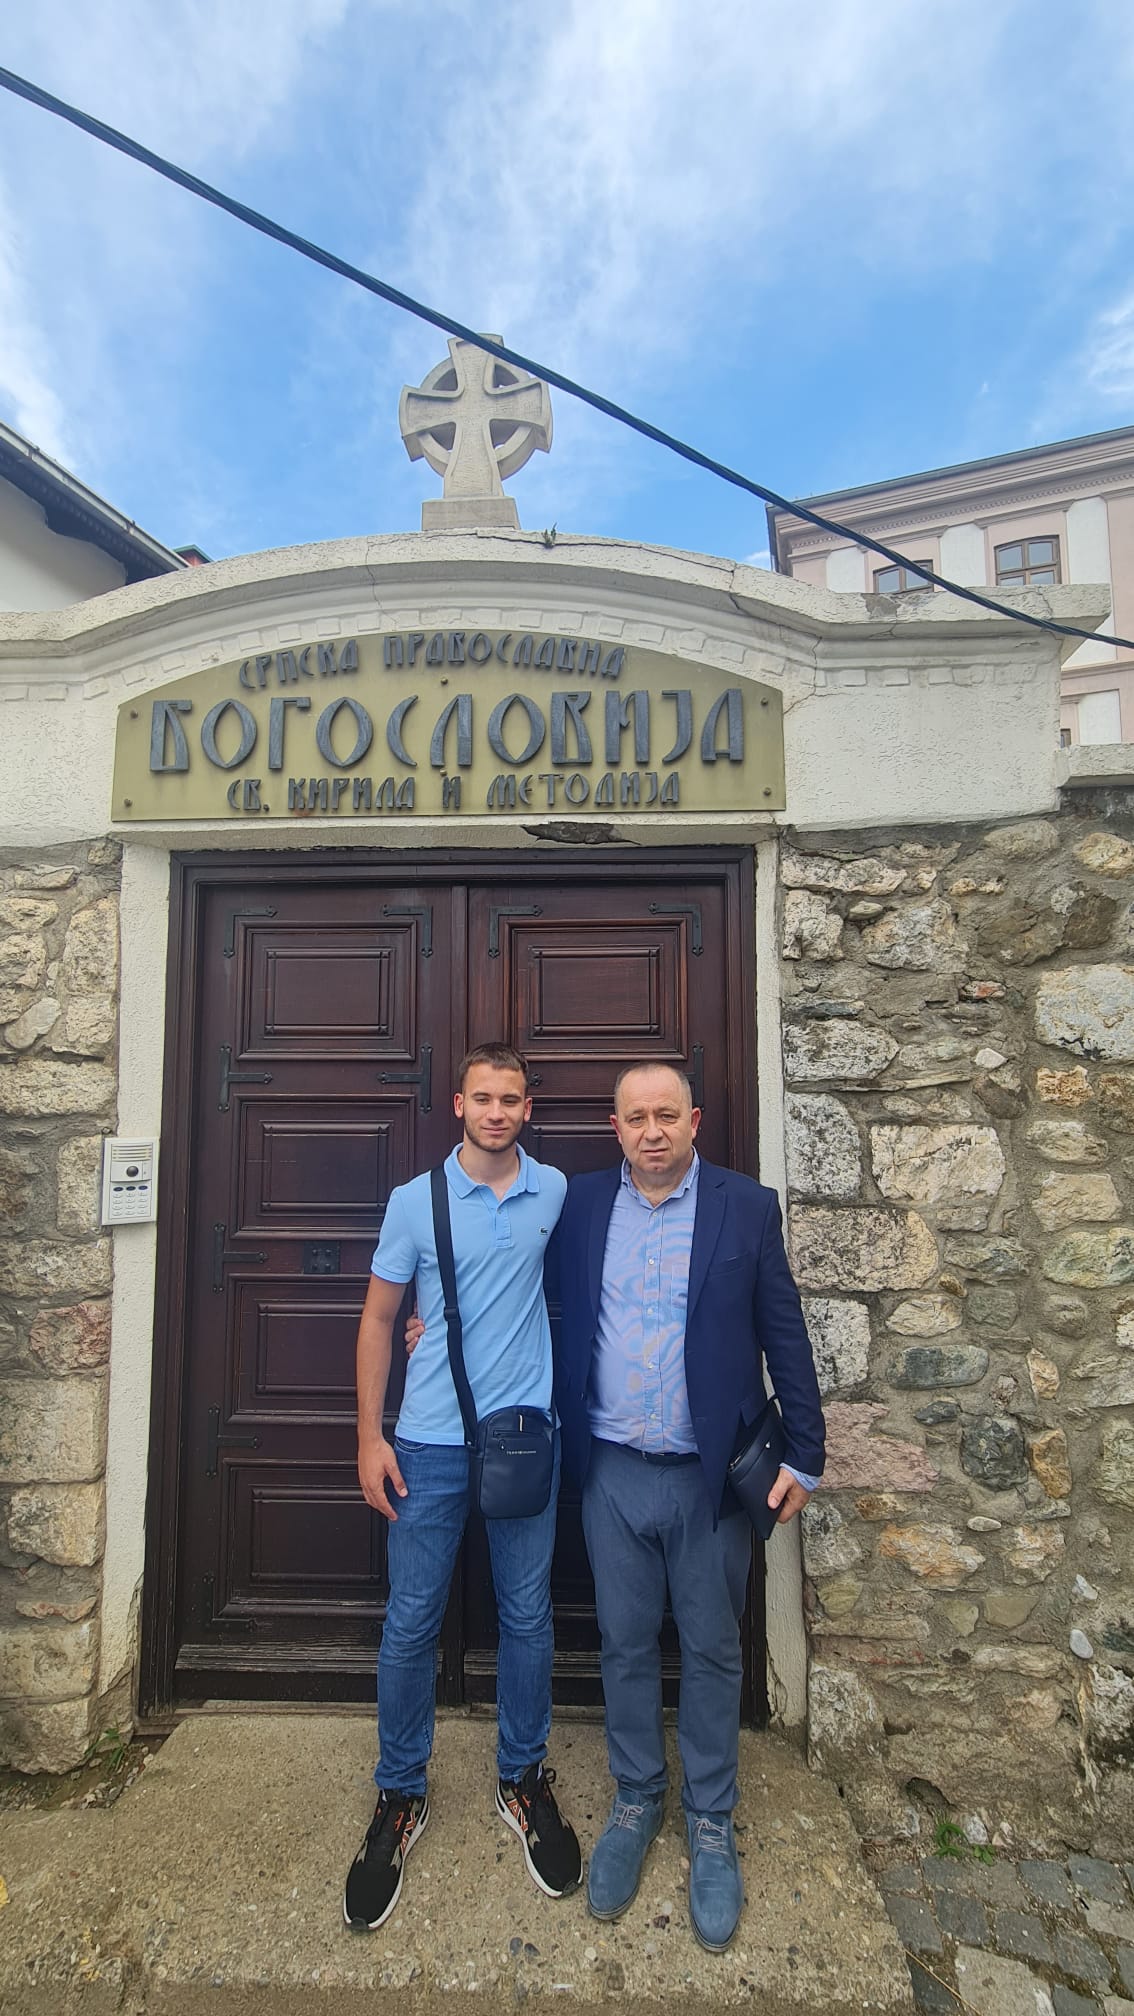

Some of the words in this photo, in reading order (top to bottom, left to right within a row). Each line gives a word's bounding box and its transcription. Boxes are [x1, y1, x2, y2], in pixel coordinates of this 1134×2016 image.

[239, 639, 359, 689] СРПСКА
[383, 631, 625, 678] ПРАВОСЛАВНА
[150, 688, 744, 772] БОГОСЛОВИЈА
[227, 778, 270, 811] СВ.
[287, 776, 416, 810] КИРИЛА
[442, 776, 462, 809] И
[486, 771, 680, 808] МЕТОДИЈА
